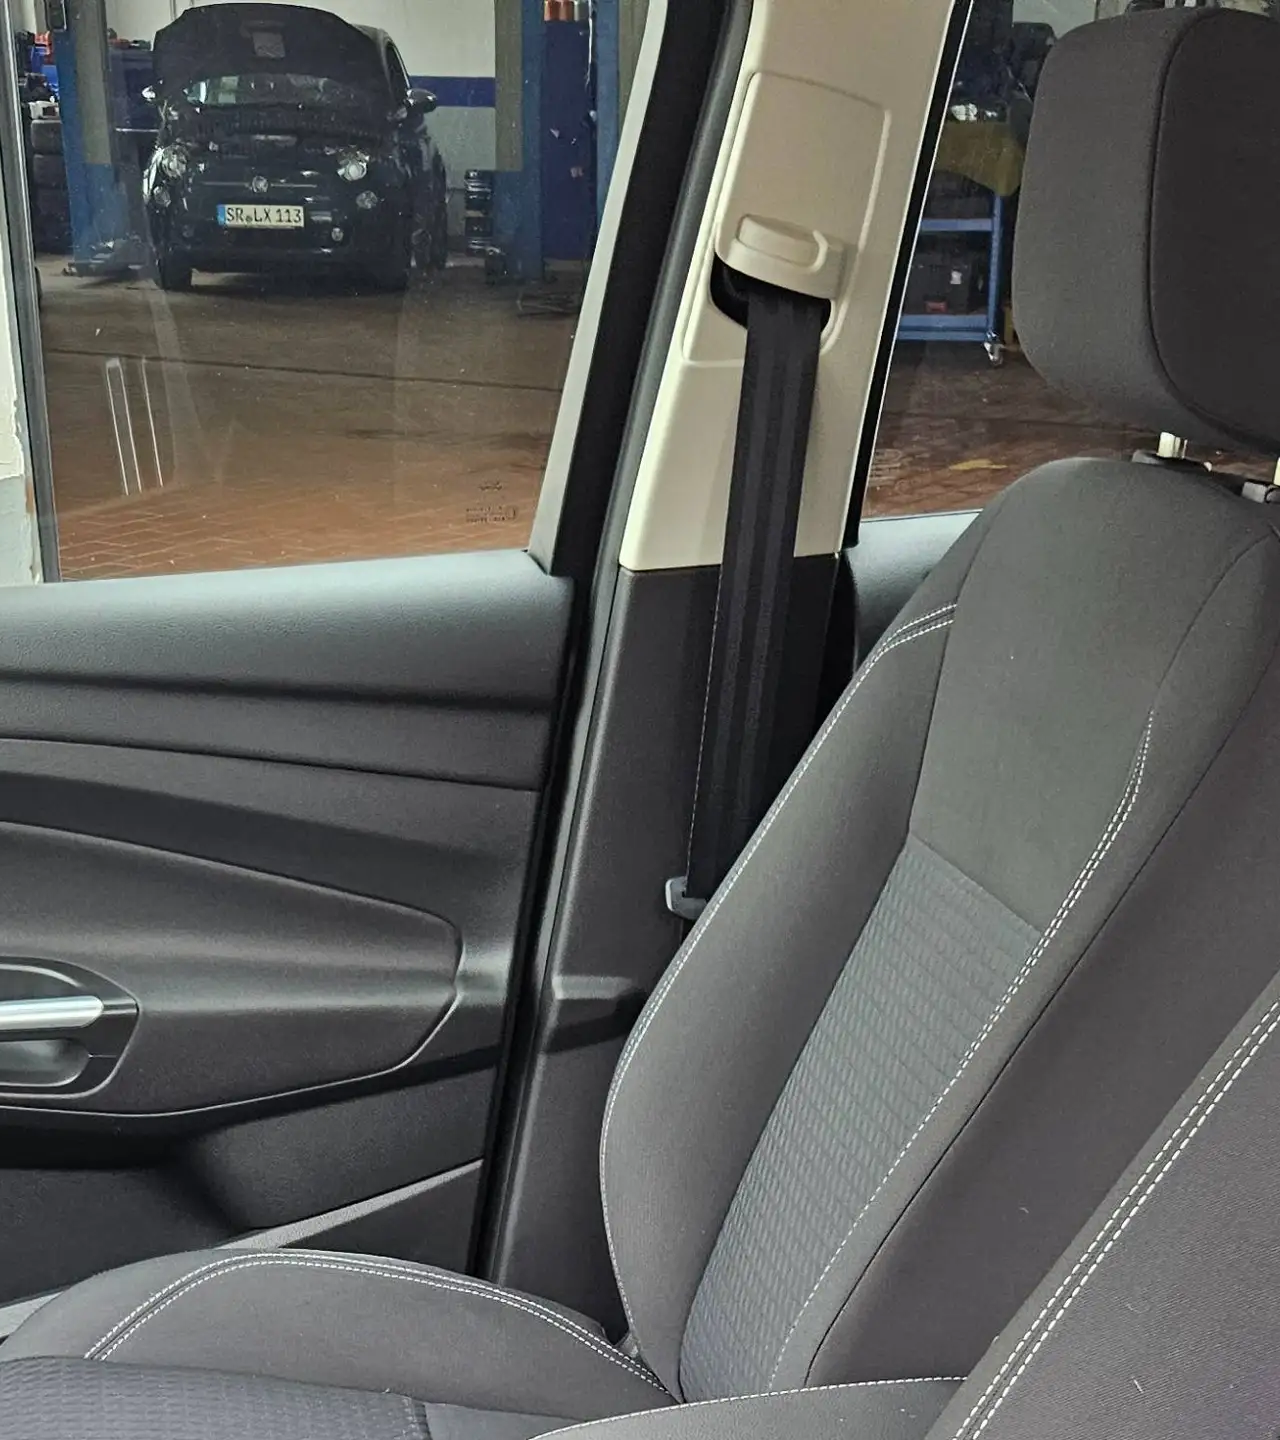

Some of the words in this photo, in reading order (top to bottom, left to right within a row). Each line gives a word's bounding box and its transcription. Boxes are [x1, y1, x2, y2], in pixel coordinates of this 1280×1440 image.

[226, 207, 244, 222] SR
[254, 208, 272, 223] LX
[275, 208, 301, 223] 113
